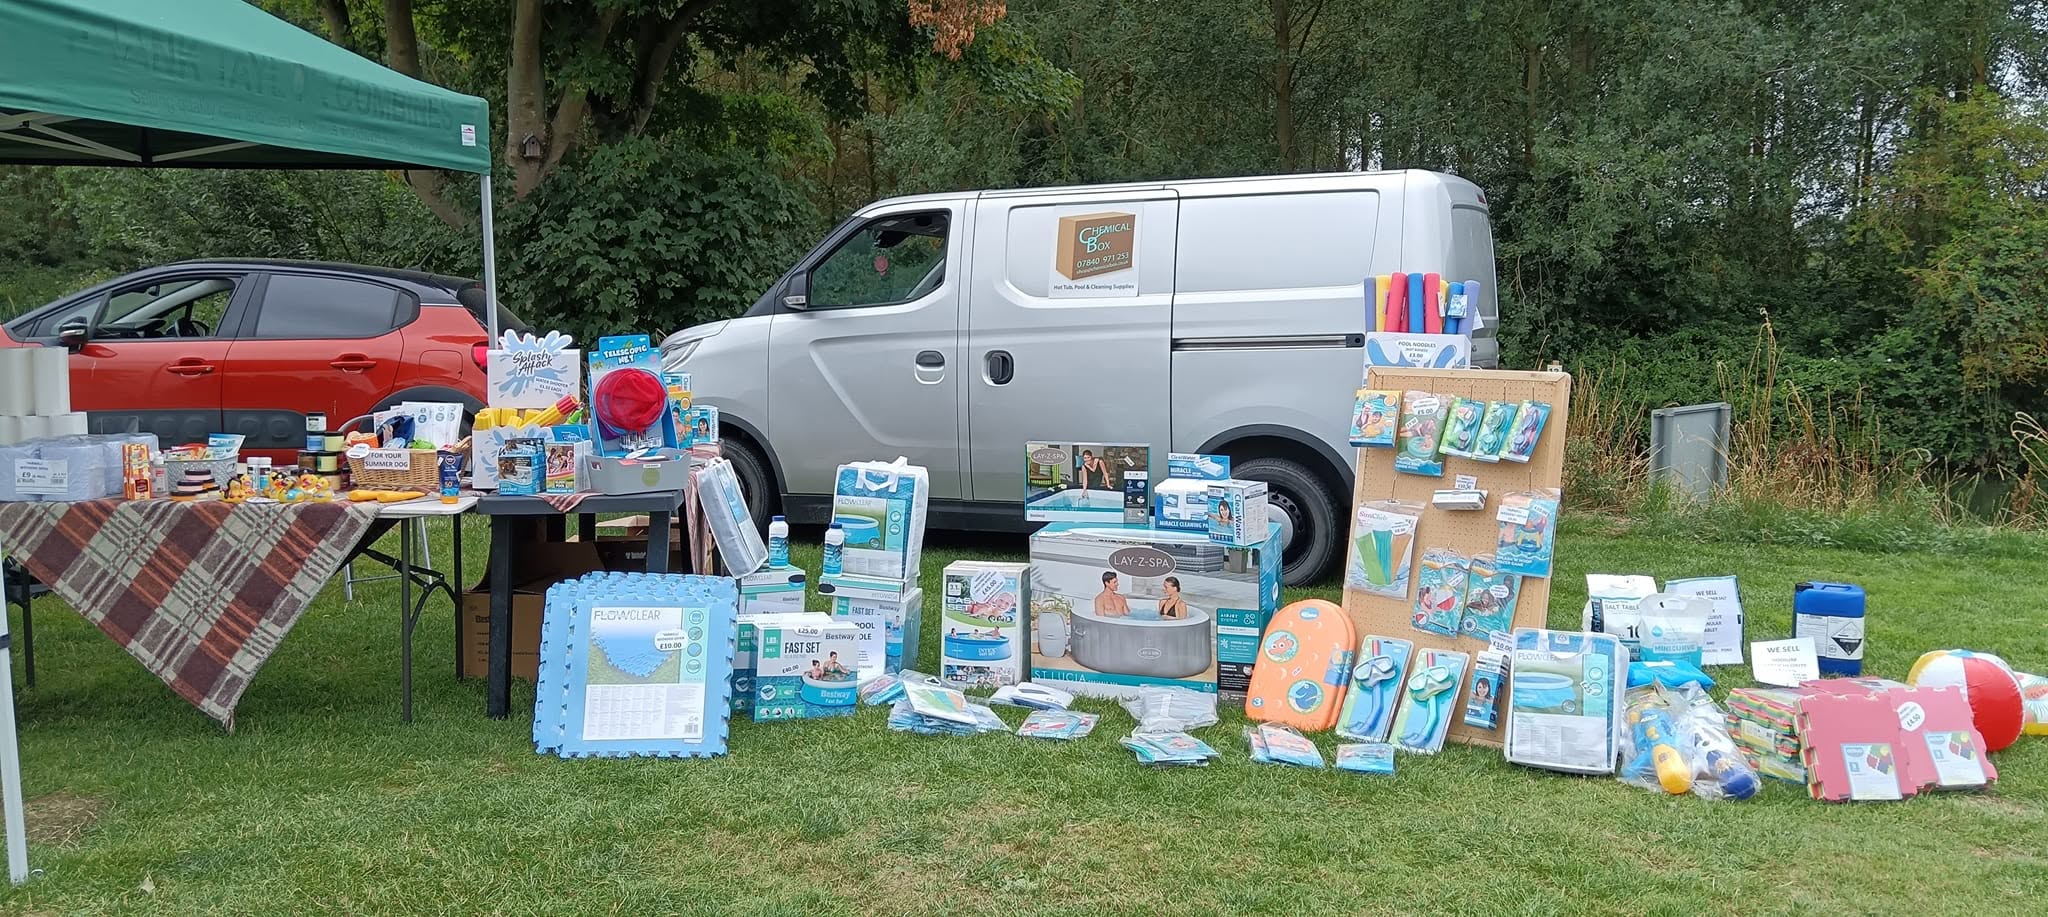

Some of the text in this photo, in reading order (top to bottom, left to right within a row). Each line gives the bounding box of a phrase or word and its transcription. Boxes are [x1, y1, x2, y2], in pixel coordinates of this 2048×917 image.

[1079, 223, 1131, 243] CHEMICAL
[1087, 237, 1111, 253] BOX
[1077, 251, 1129, 268] 07840 971 253
[513, 350, 551, 365] Splash
[604, 345, 647, 359] TELESCOPIC
[519, 356, 552, 375] Attack
[618, 354, 634, 365] NET
[1114, 555, 1170, 568] LAY-Z-SPA
[982, 579, 997, 595] £45.00
[852, 607, 875, 616] FAST SET
[879, 604, 900, 613] Bestway
[594, 609, 662, 621] FLOWCLEAR
[660, 642, 682, 650] £10.00
[784, 642, 804, 654] FAST
[805, 641, 821, 653] SET
[1493, 640, 1512, 651] £10.00
[1654, 643, 1696, 652] MINICURVE
[782, 665, 799, 674] £40.00
[1049, 671, 1086, 683] LUCIA
[820, 690, 851, 698] Bestway
